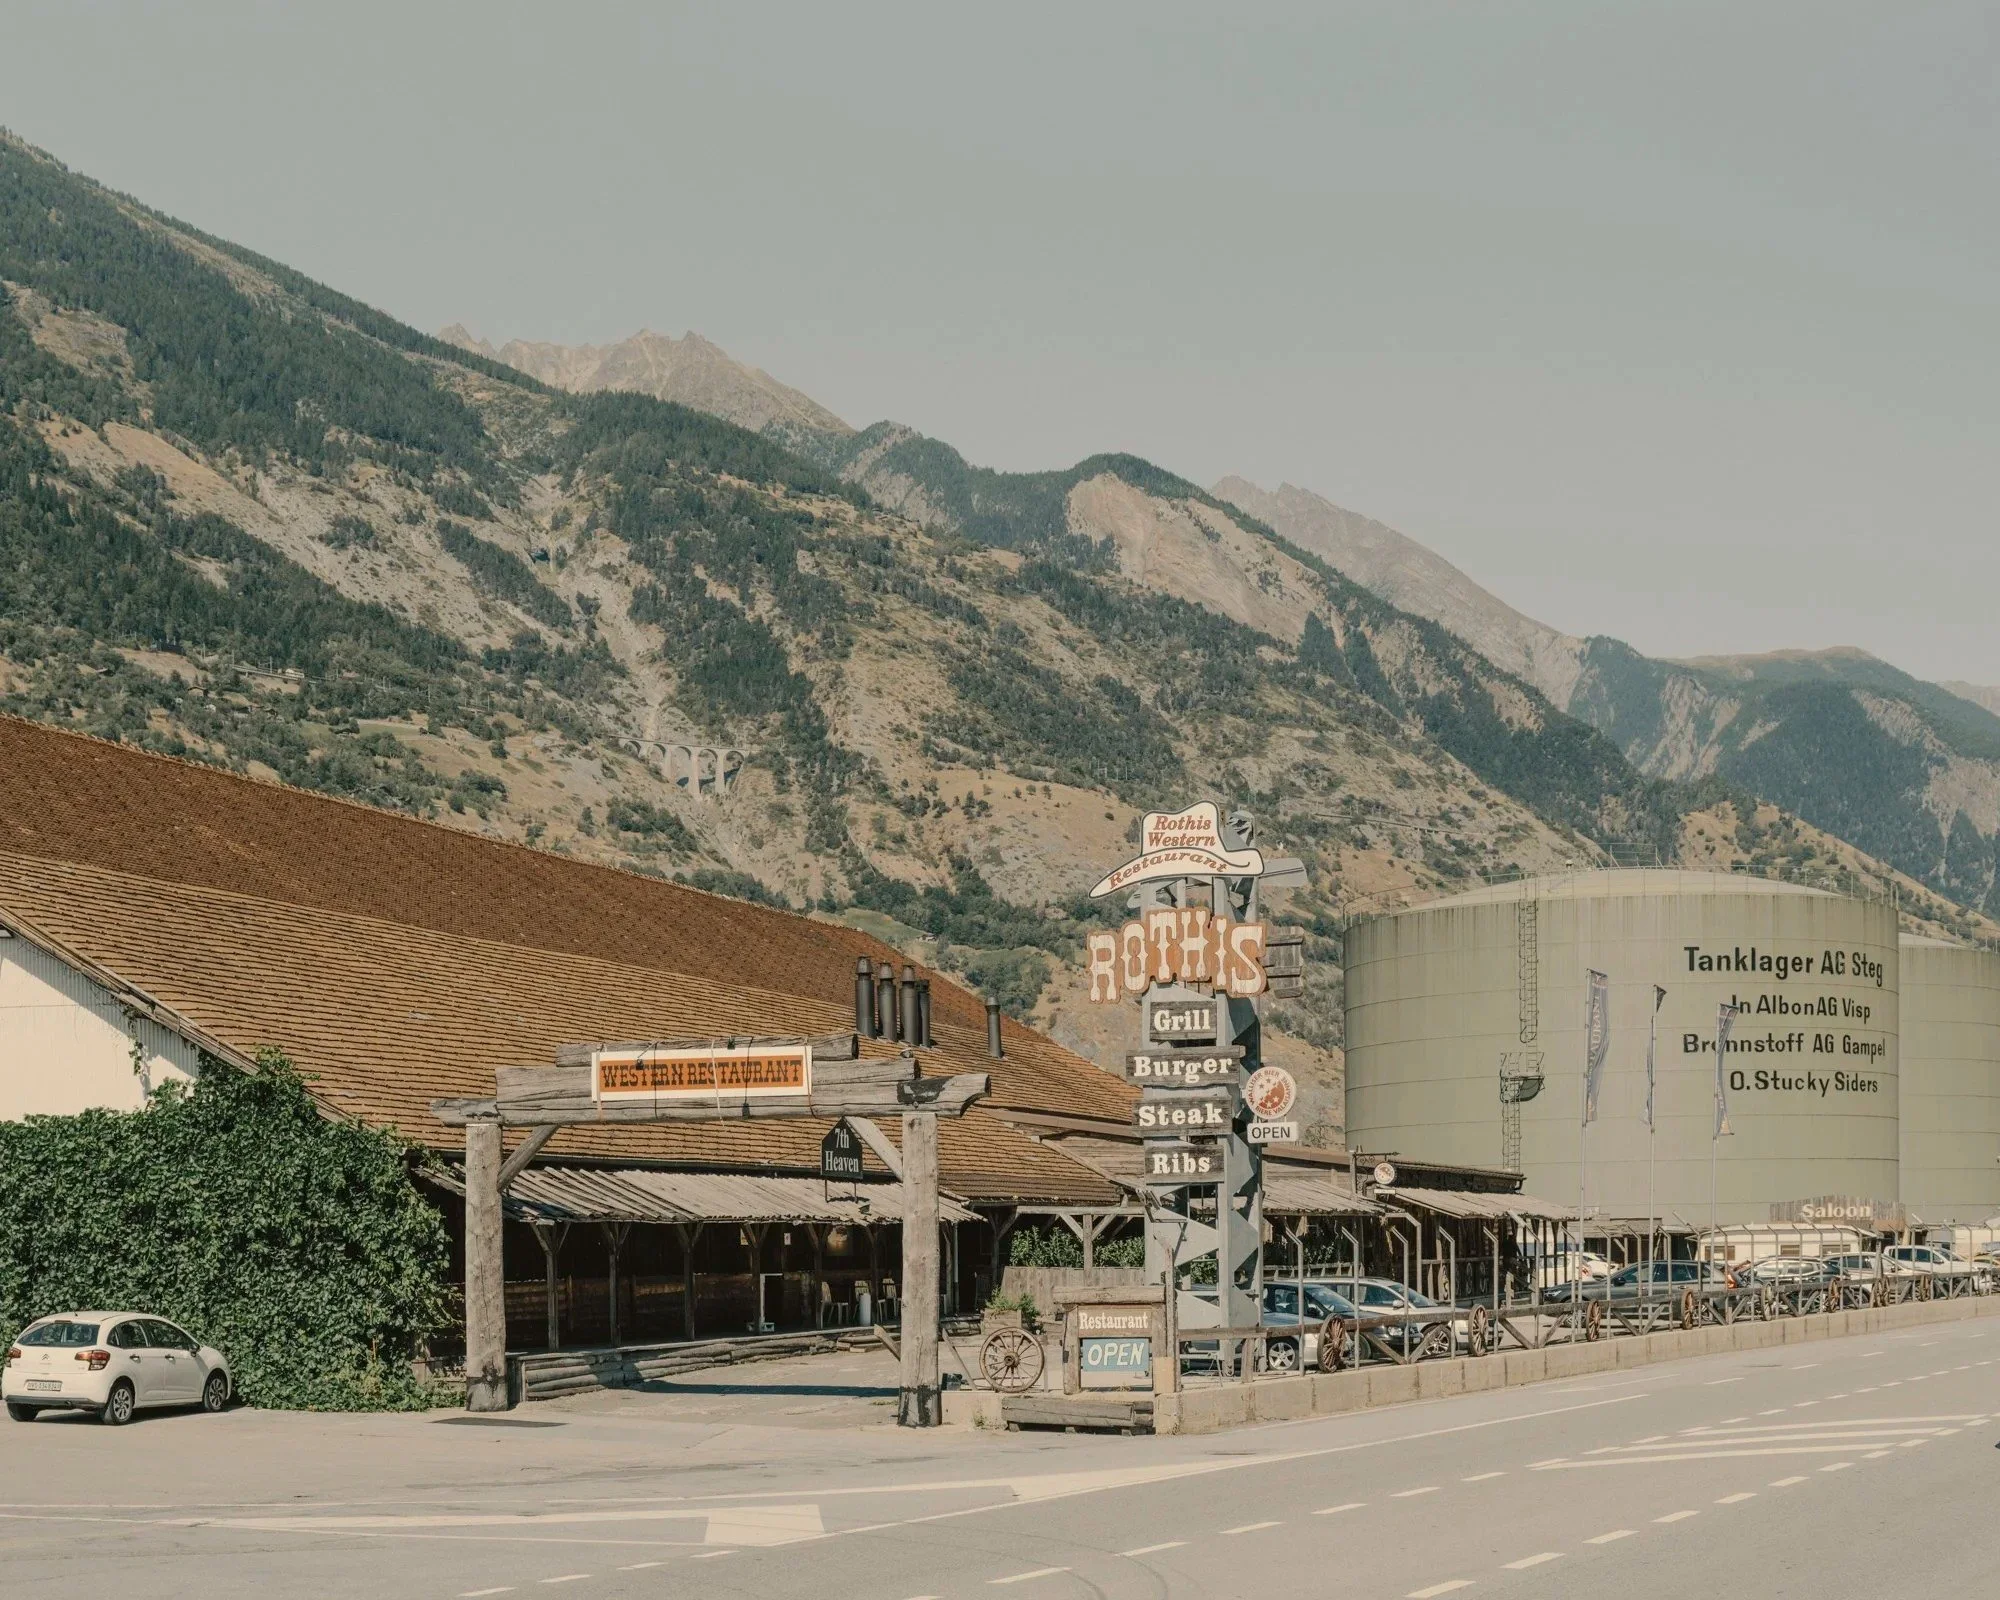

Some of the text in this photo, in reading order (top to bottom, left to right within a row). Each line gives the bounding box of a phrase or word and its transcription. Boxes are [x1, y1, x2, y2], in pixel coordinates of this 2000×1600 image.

[1153, 815, 1211, 831] Rothis
[1148, 832, 1216, 847] Western
[1108, 852, 1228, 889] Restaurant
[1089, 910, 1264, 1002] ROTHIS
[1684, 947, 1883, 988] Tanklager AG Steg
[1153, 1009, 1211, 1032] Grill
[1756, 995, 1814, 1016] Albon
[1817, 997, 1838, 1016] AG
[1842, 997, 1871, 1024] Visp
[1813, 1034, 1834, 1054] AG
[1843, 1034, 1886, 1064] Gampel
[602, 1060, 802, 1088] WESTERN RESTAURANT
[1133, 1056, 1233, 1083] Burger
[1834, 1071, 1878, 1093] Siders
[1138, 1103, 1224, 1126] Steak
[835, 1128, 850, 1148] 7th
[1251, 1127, 1290, 1139] OPEN
[825, 1151, 859, 1172] Heaven
[1152, 1153, 1211, 1174] Ribs
[1802, 1203, 1873, 1219] Saloon
[1080, 1312, 1149, 1330] Restaurant
[1088, 1342, 1145, 1366] OPEN
